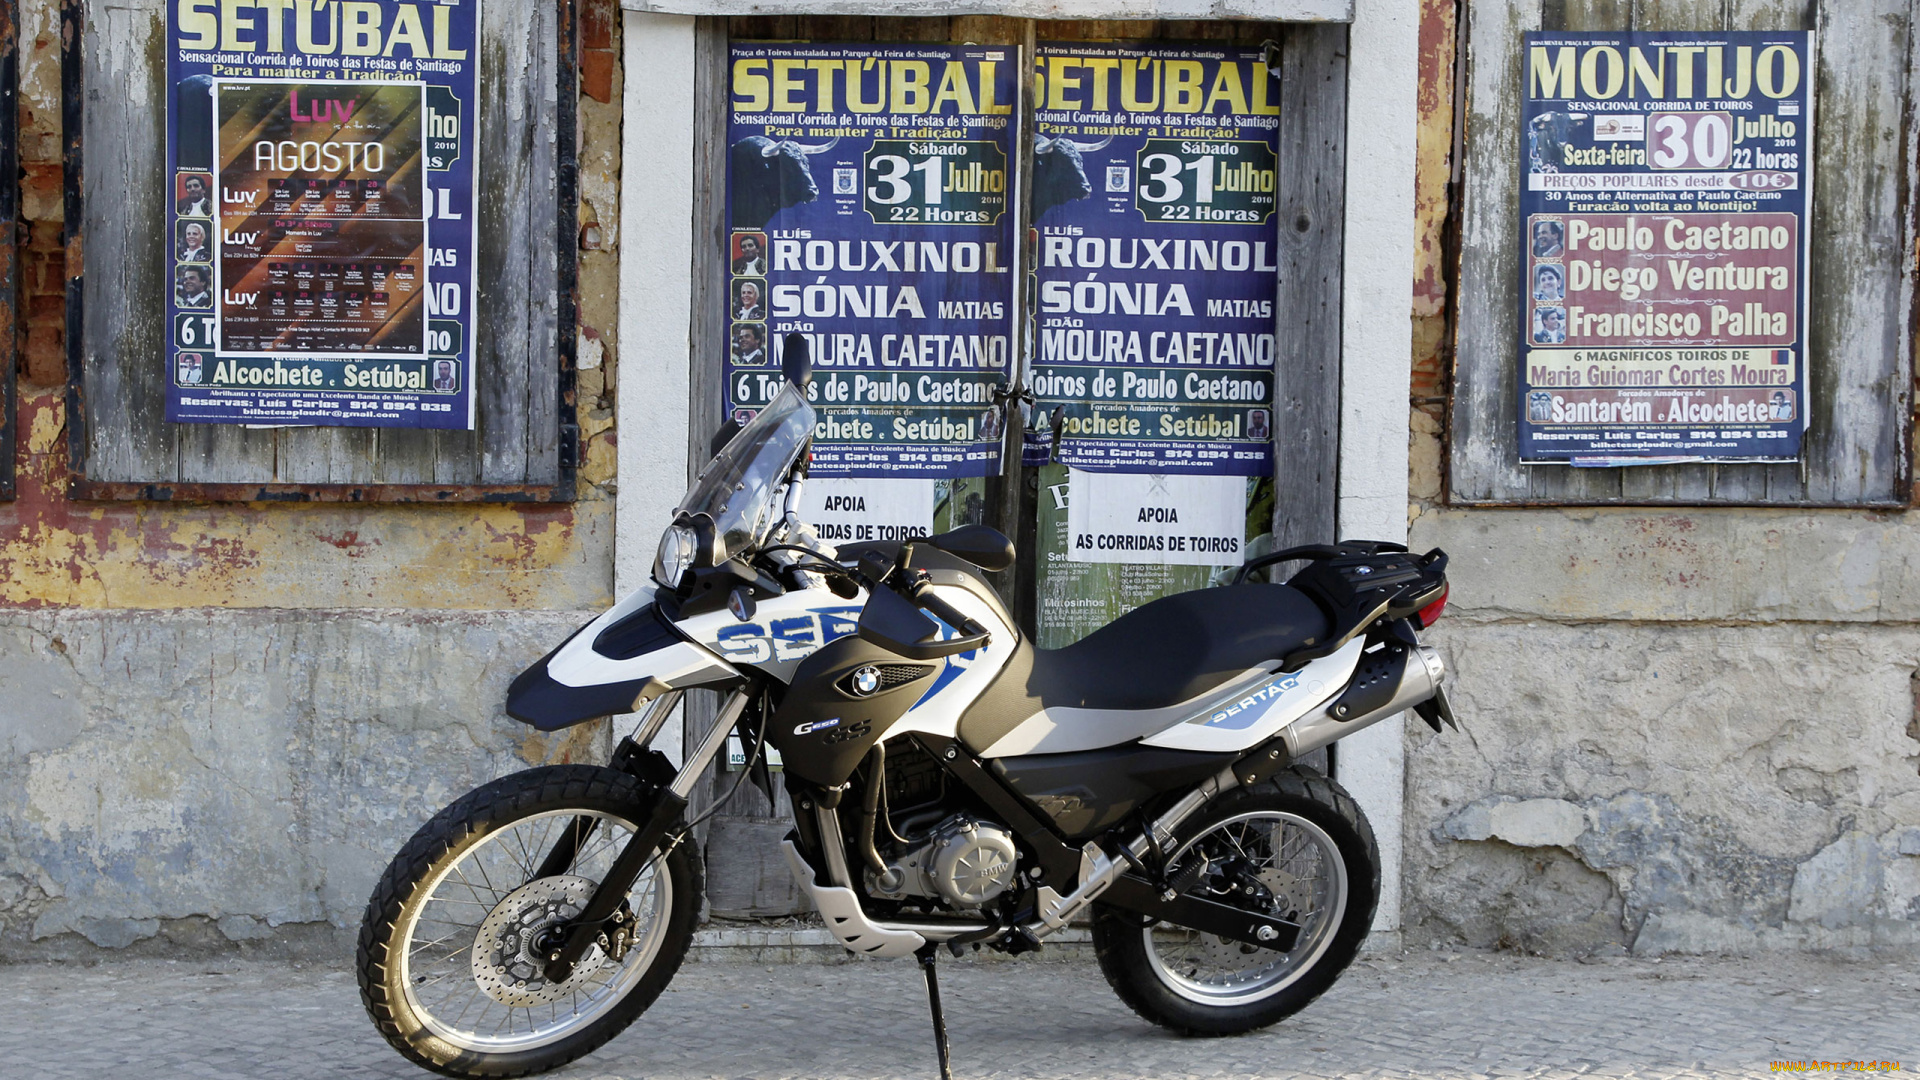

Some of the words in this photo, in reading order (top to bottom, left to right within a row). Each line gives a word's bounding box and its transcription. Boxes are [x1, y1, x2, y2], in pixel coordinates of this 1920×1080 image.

[178, 0, 467, 60] SETÚBAL
[179, 50, 244, 64] Sensacional
[247, 53, 286, 65] Corrida
[289, 55, 303, 66] de
[306, 54, 339, 68] Toiros
[342, 56, 361, 68] das
[364, 57, 397, 70] Festas
[400, 59, 412, 70] de
[416, 59, 461, 75] Santiago
[732, 49, 752, 57] Praça
[843, 50, 870, 58] Parque
[917, 51, 951, 59] Santiago
[212, 64, 253, 76] Para
[259, 67, 320, 79] manter
[325, 70, 336, 79] a
[1530, 45, 1800, 99] MONTIJO
[733, 57, 1012, 114] SETÚBAL
[1035, 56, 1280, 115] ETÚBAL
[290, 90, 355, 122] Luv
[1567, 101, 1641, 111] SENSACIONAL
[1643, 101, 1692, 110] CORRIDA
[1695, 101, 1710, 110] DE
[1713, 101, 1753, 110] TOIROS
[909, 142, 967, 155] Sábado
[1181, 142, 1239, 155] Sábado
[1653, 115, 1729, 168] 30
[1733, 114, 1796, 145] Julho
[255, 141, 383, 172] AGOSTO
[1564, 142, 1645, 165] Sexta-feira
[1732, 148, 1752, 169] 22
[1756, 147, 1798, 169] horas
[868, 155, 942, 204] 31
[943, 162, 1003, 192] Julho
[1139, 153, 1214, 203] 31
[1215, 162, 1273, 192] Julho
[1543, 175, 1596, 190] PREÇOS
[1603, 175, 1678, 188] POPULARES
[1685, 175, 1723, 187] desde
[1736, 173, 1786, 188] 10€
[224, 187, 256, 203] Luv
[1545, 191, 1562, 200] 30
[1565, 191, 1593, 200] Anos
[1597, 191, 1611, 200] de
[1614, 191, 1676, 200] Alternativa
[1680, 191, 1694, 200] de
[1698, 191, 1730, 200] Paulo
[1734, 191, 1781, 200] Caetano
[890, 207, 919, 221] 22
[925, 207, 990, 222] Horas
[1161, 206, 1190, 220] 22
[1196, 206, 1259, 221] Horas
[1568, 202, 1629, 211] Furacão
[1634, 201, 1669, 211] volta
[1673, 203, 1692, 211] ao
[1697, 201, 1757, 212] Montijo!
[224, 229, 257, 244] Luv
[773, 228, 811, 239] LUÍS
[1044, 225, 1083, 236] LUÍS
[1568, 218, 1653, 250] Paulo
[1664, 220, 1789, 250] Caetano
[773, 240, 1008, 273] ROUXINOL
[1044, 237, 1276, 272] ROUXINOL
[1569, 260, 1658, 300] Diego
[1668, 260, 1788, 291] Ventura
[225, 289, 257, 305] Luv
[772, 276, 926, 319] SÓNIA
[938, 301, 1003, 320] MATIAS
[1042, 273, 1194, 316] SÓNIA
[1207, 299, 1271, 318] MATIAS
[181, 317, 195, 345] 6
[773, 321, 814, 332] JOÃO
[1043, 317, 1083, 328] JOÃO
[1569, 306, 1701, 337] Francisco
[1710, 303, 1787, 336] Palha
[881, 334, 1007, 367] CAETANO
[1041, 329, 1143, 363] MOURA
[1150, 331, 1275, 366] CAETANO
[1574, 352, 1582, 361] 6
[1586, 349, 1672, 361] MAGNÍFICOS
[1677, 351, 1727, 361] TOIROS
[1732, 350, 1750, 360] DE
[213, 360, 323, 386] Alcochete
[344, 364, 426, 388] Setúbal
[1092, 369, 1116, 398] de
[1123, 370, 1177, 399] Paulo
[1184, 372, 1265, 400] Caetano
[1531, 365, 1581, 386] Maria
[1587, 365, 1663, 386] Guiomar
[1668, 364, 1725, 385] Cortes
[1731, 364, 1787, 385] Moura
[737, 374, 750, 401] 6
[757, 375, 818, 401] Tois
[824, 373, 848, 402] de
[855, 374, 910, 402] Paulo
[180, 397, 253, 407] Reservas:
[259, 399, 287, 408] Luís
[292, 400, 339, 409] Carlos
[350, 401, 378, 410] 914
[383, 402, 416, 411] 094
[421, 402, 451, 411] 038
[243, 408, 399, 419] bilhetesaplaudir@gmail.com
[862, 408, 901, 416] Amadores
[903, 408, 913, 416] de
[1551, 396, 1651, 423] Santarém
[1657, 413, 1665, 421] e
[1668, 396, 1768, 422] Alcochete
[1532, 432, 1600, 440] Reservas:
[1636, 431, 1680, 440] Carlos
[1690, 431, 1717, 439] 914
[1721, 431, 1752, 439] 094
[1757, 430, 1788, 439] 038
[1590, 441, 1737, 449] bilhetesaplaudir@gmail.com
[824, 496, 866, 511] APOIA
[1137, 507, 1178, 523] APOIA
[1076, 534, 1093, 549] AS
[1097, 534, 1164, 551] CORRIDAS
[1168, 536, 1185, 551] DE
[1190, 537, 1238, 553] TOIROS
[1210, 676, 1297, 724] SERTÃO
[978, 862, 1009, 878] BMW
